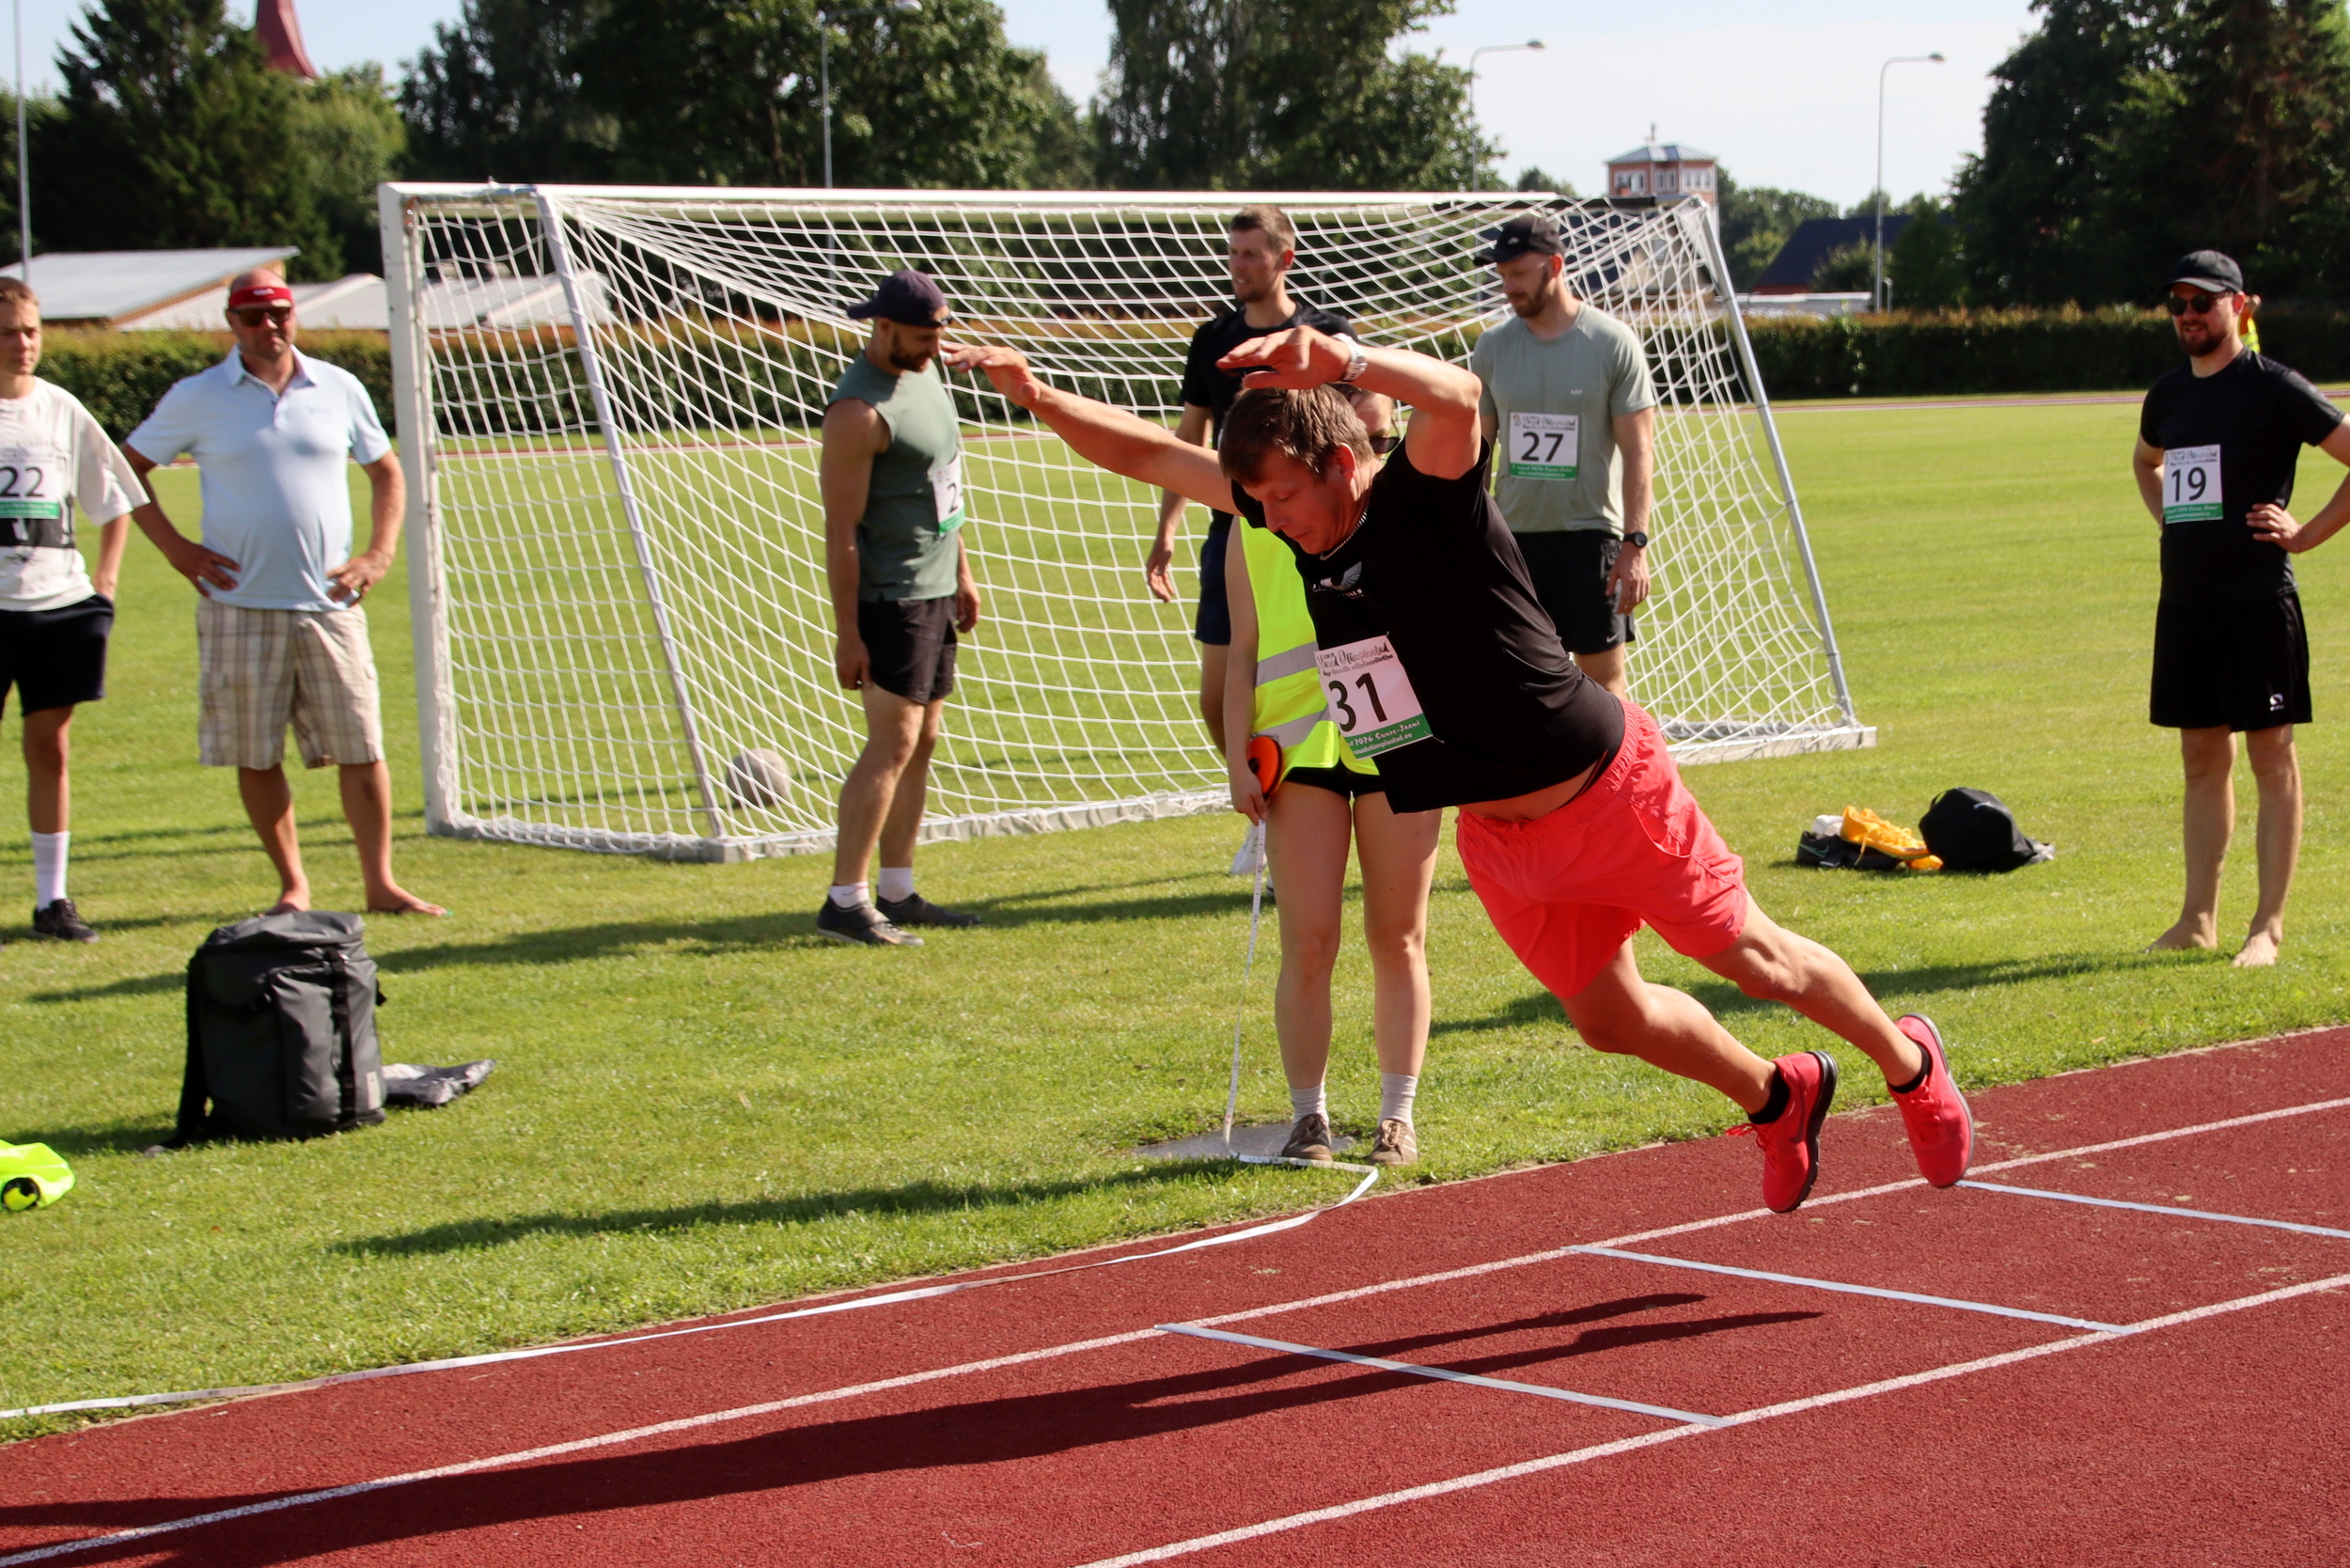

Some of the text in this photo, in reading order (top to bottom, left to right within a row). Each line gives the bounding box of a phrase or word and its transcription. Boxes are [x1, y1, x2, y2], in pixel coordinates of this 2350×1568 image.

[1521, 431, 1563, 463] 27
[0, 466, 43, 496] 22
[2171, 466, 2206, 502] 19
[1328, 672, 1387, 732] 31
[1355, 735, 1373, 746] 2026
[1375, 720, 1420, 740] Suure-Jaani
